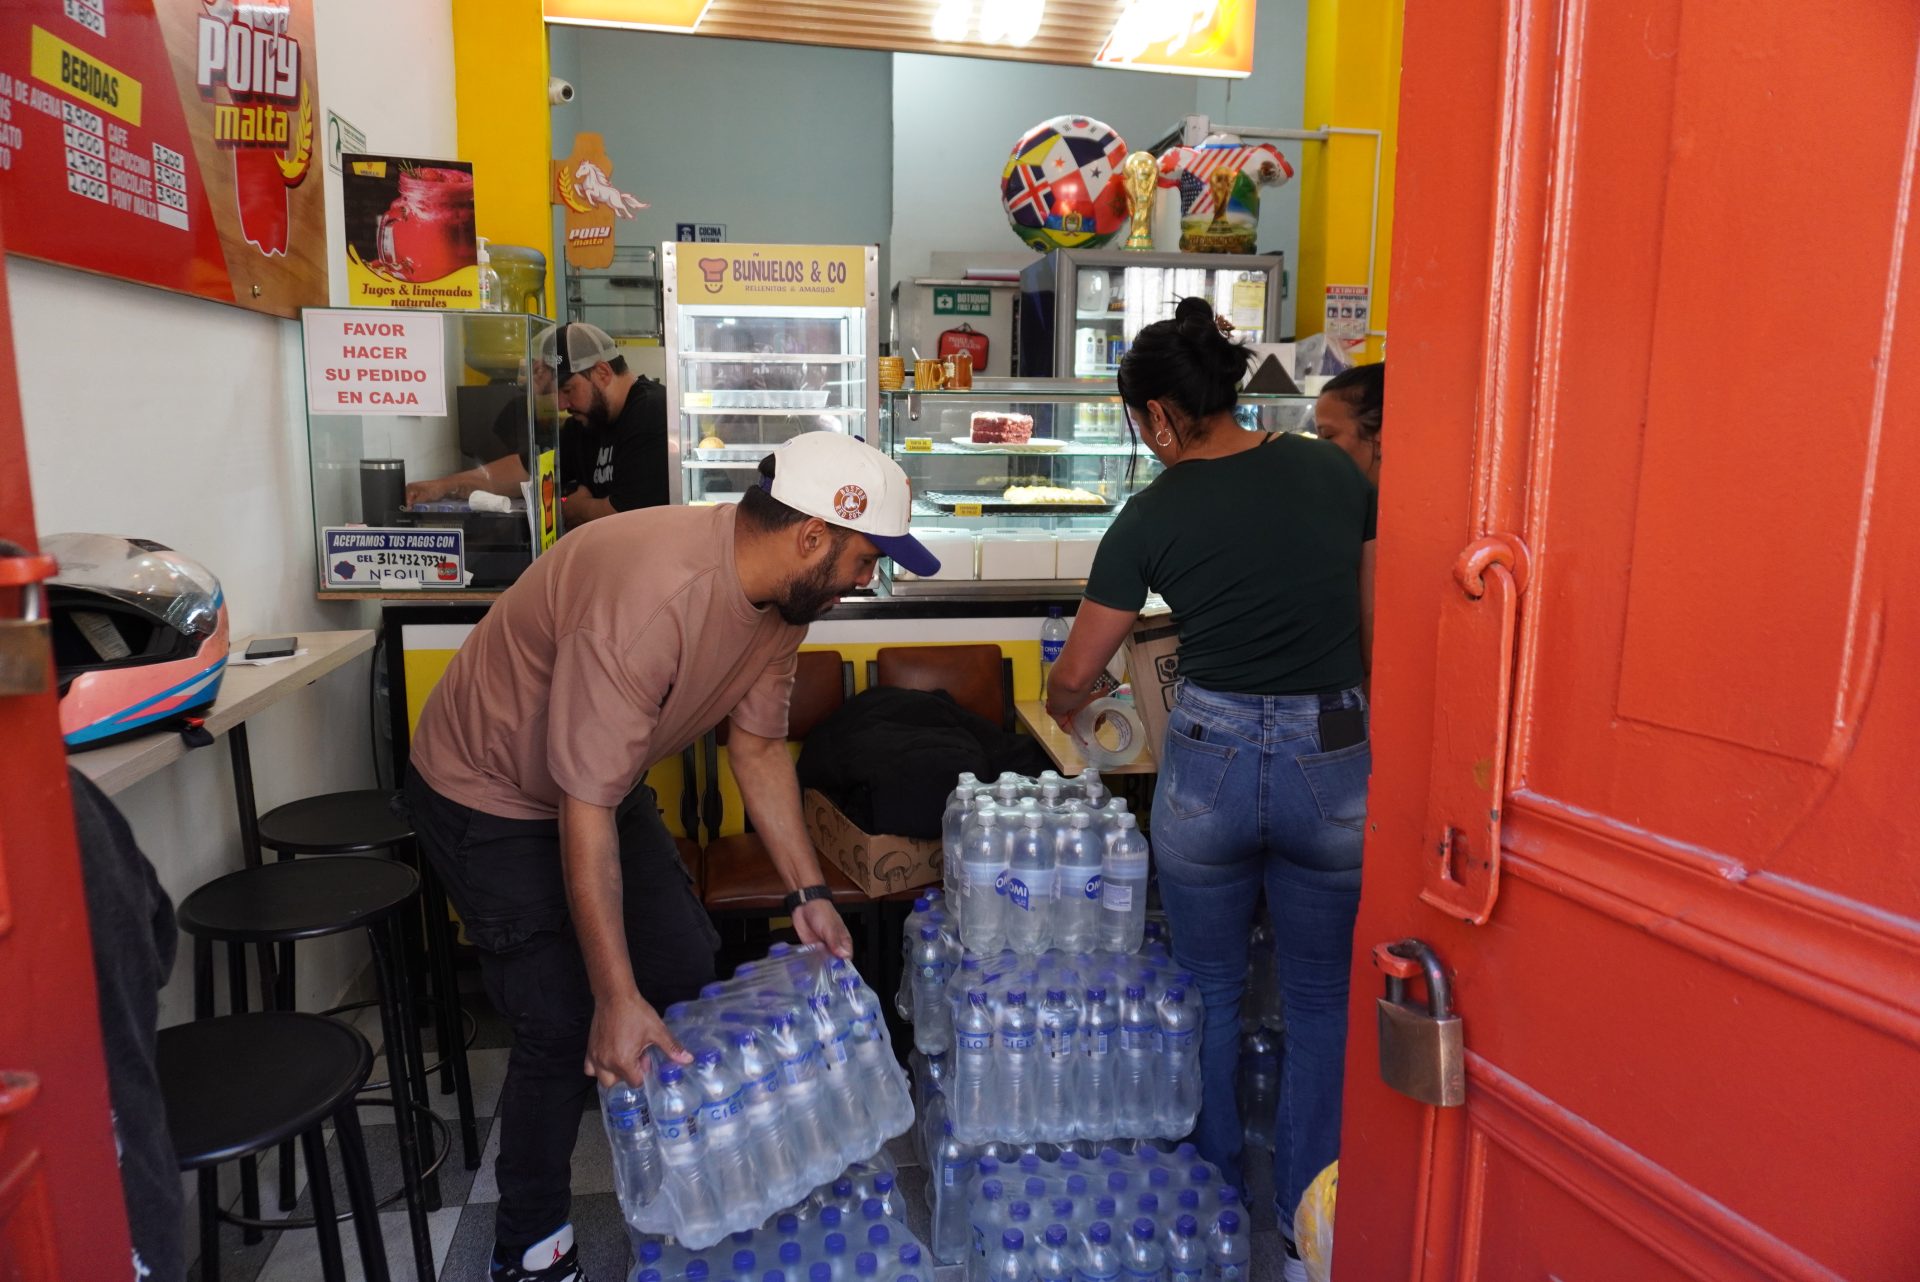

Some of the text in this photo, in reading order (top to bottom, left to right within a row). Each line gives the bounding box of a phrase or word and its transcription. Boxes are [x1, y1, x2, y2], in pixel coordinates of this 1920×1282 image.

[61, 49, 119, 108] BEBIDAS
[215, 104, 288, 142] malta
[699, 226, 722, 237] COCINA
[733, 252, 847, 285] BUÑUELOS & CO
[362, 283, 473, 298] Jugos & limonadas
[745, 285, 787, 293] RELLENITOS
[391, 297, 448, 309] naturales
[343, 322, 406, 337] FAVOR
[343, 345, 408, 360] HACER
[325, 368, 427, 382] SU PEDIDO
[337, 391, 419, 405] EN CAJA
[839, 485, 867, 502] BOSTON
[835, 504, 862, 520] RED SOX
[333, 534, 455, 548] ACEPTAMOS TUS PAGOS CON
[357, 555, 374, 563] CEL
